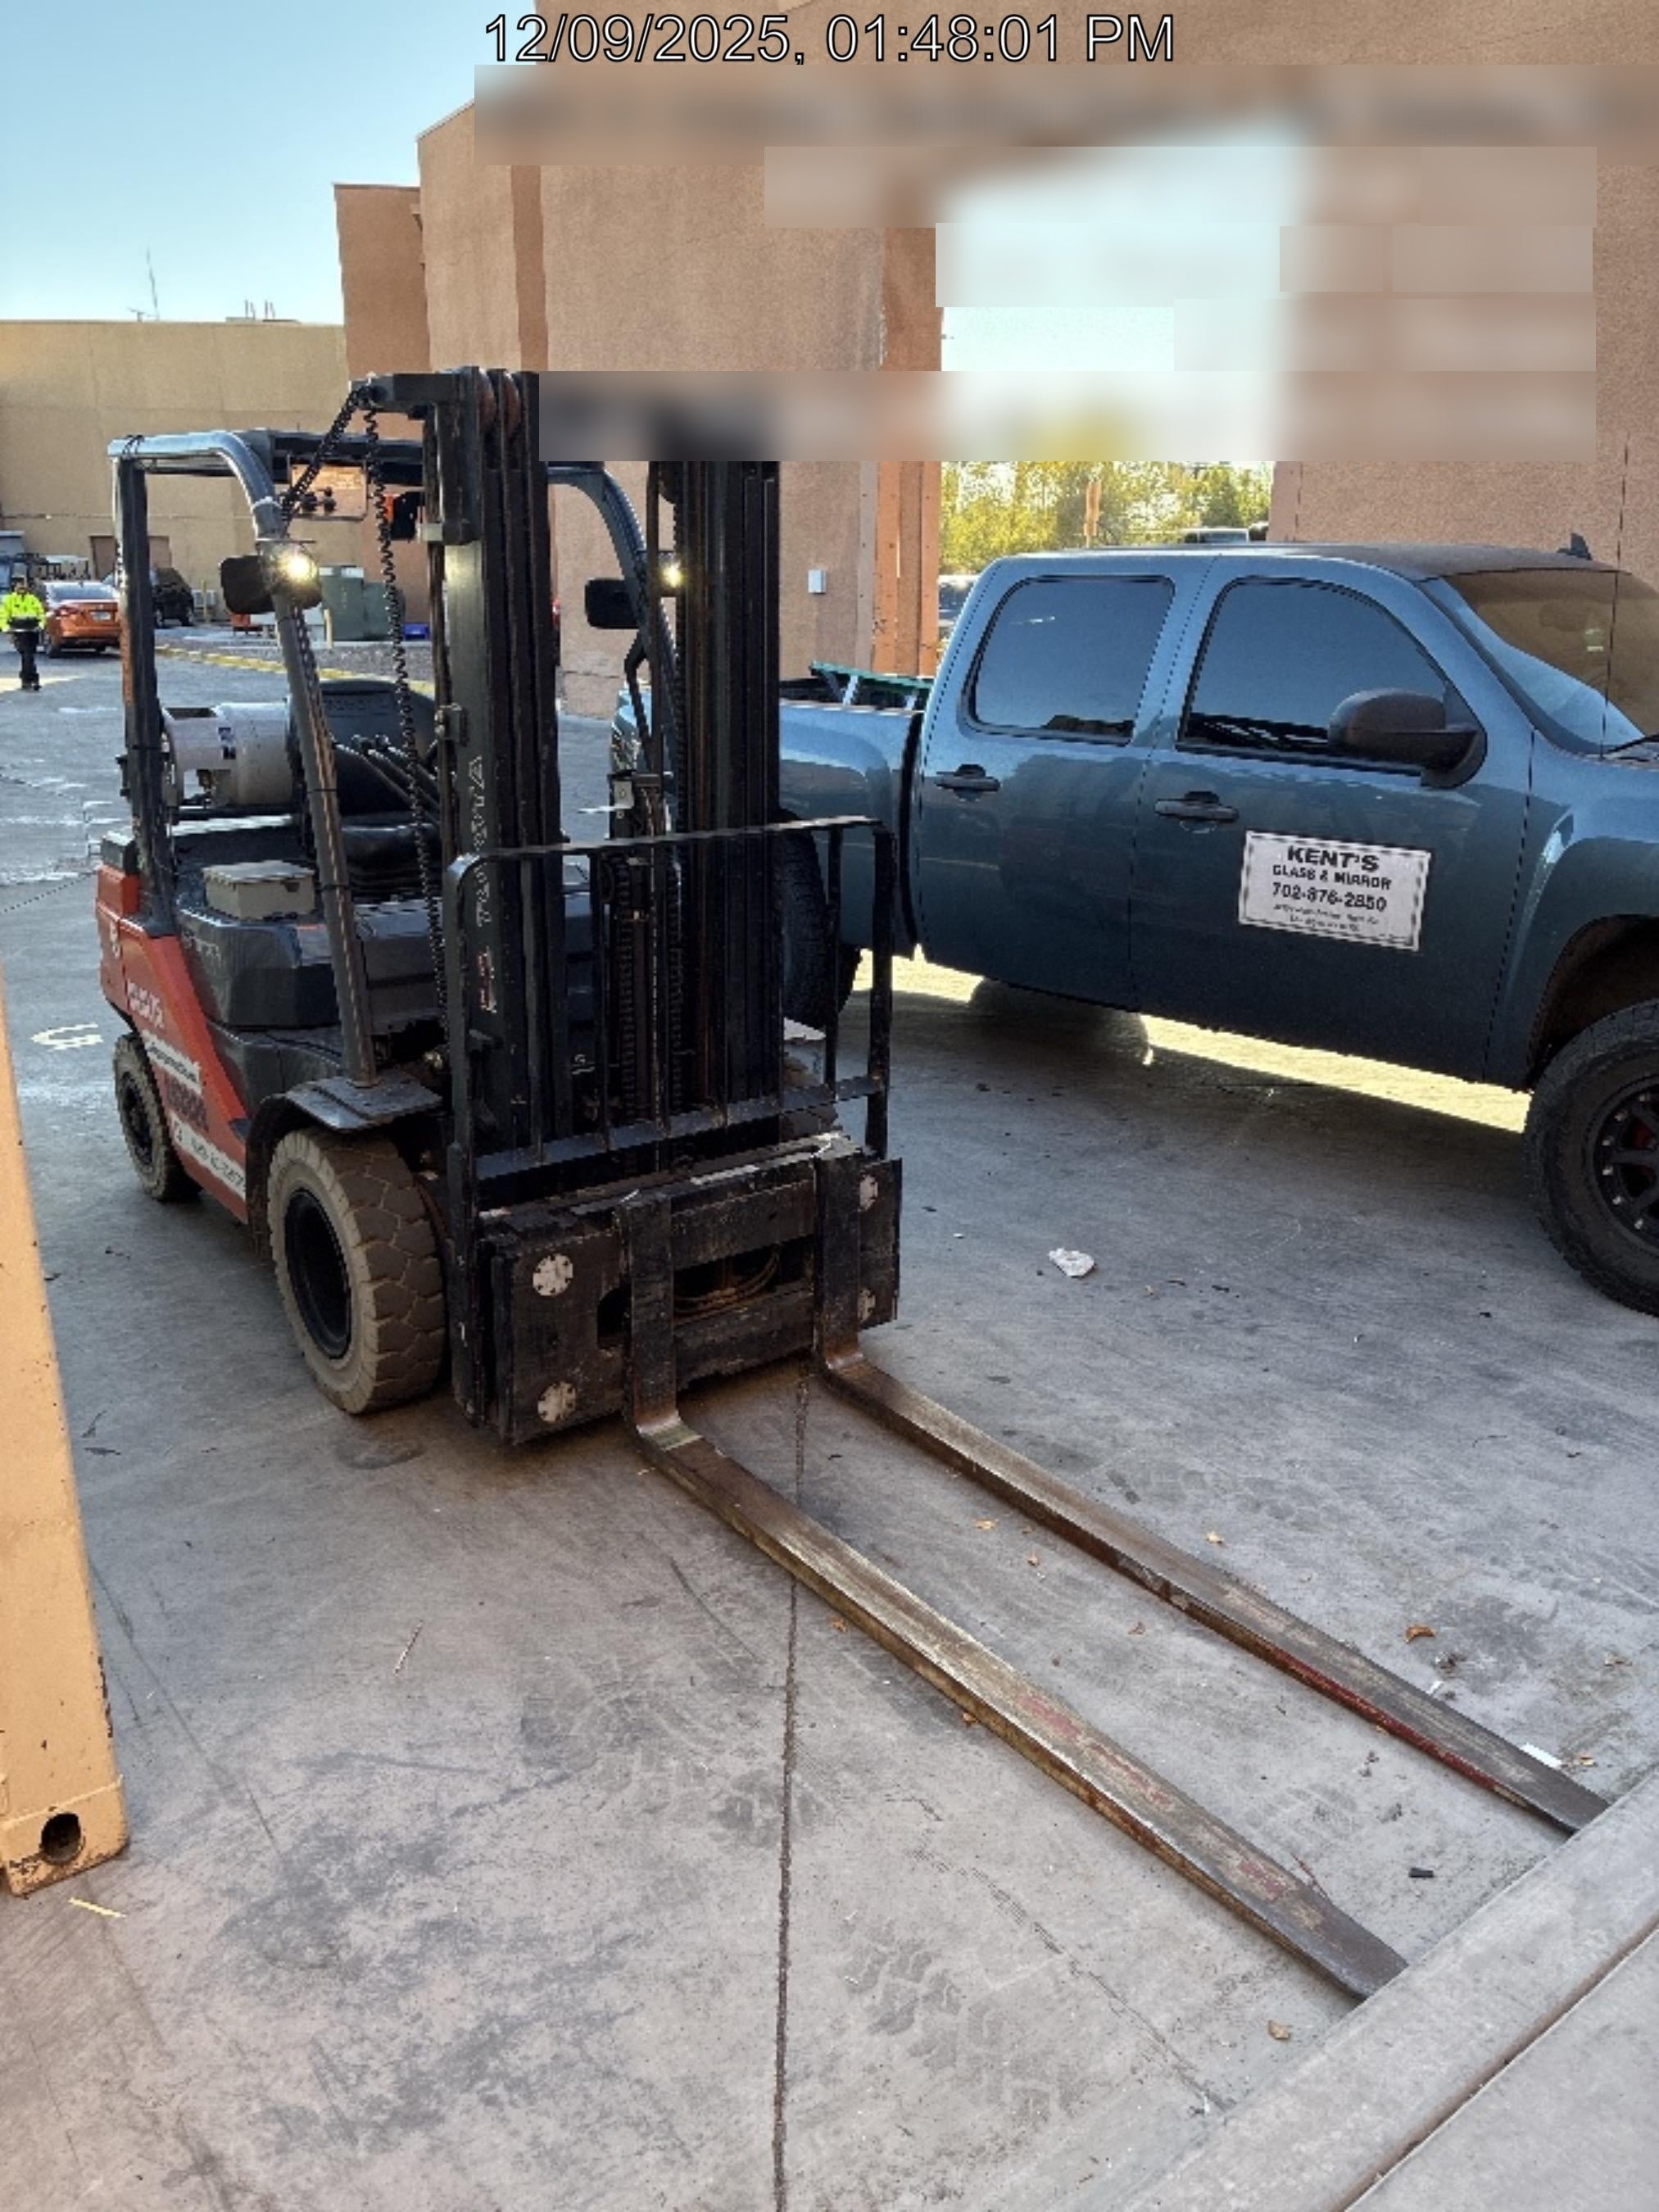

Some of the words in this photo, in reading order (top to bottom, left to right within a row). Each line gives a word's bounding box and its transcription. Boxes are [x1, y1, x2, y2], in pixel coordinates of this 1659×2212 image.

[1288, 845, 1380, 872] KENT'S
[1272, 865, 1316, 880] GLASS
[1319, 871, 1328, 882] &
[1335, 873, 1392, 891] MIRROR
